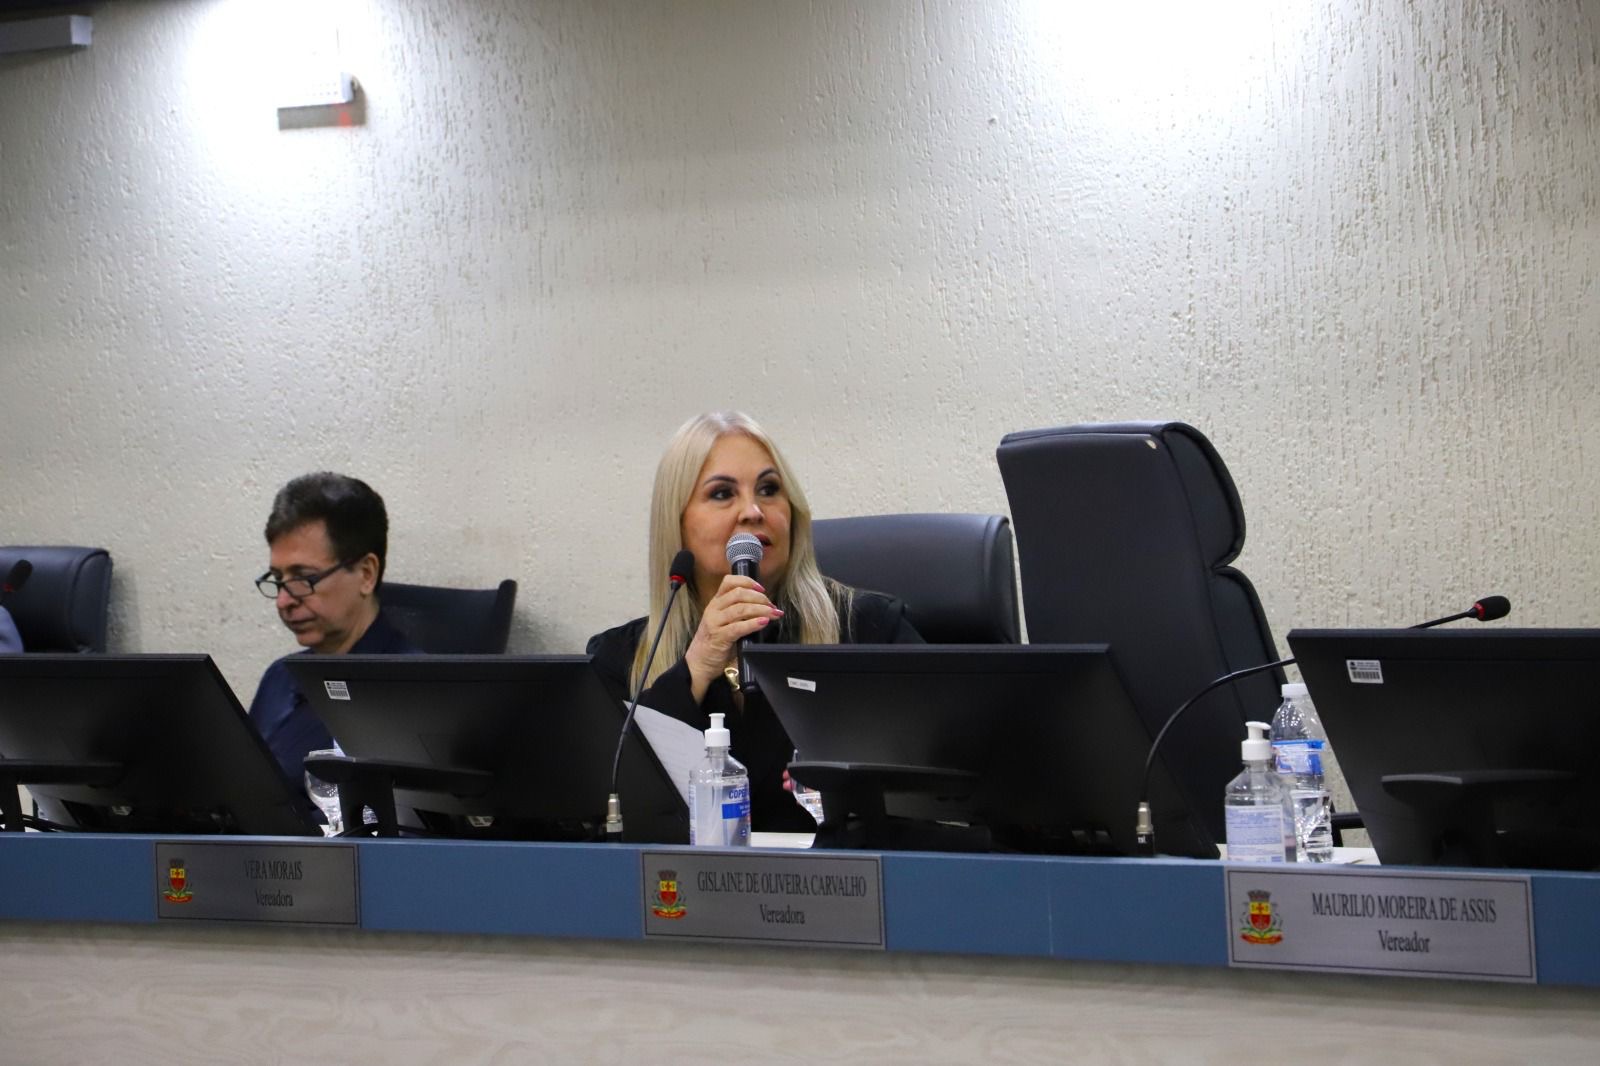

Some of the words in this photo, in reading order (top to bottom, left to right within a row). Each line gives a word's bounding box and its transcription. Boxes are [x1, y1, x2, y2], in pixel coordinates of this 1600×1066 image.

[244, 860, 268, 878] VERA
[269, 861, 303, 881] MORAIS
[697, 871, 744, 893] GISLAINE
[745, 872, 760, 894] DE
[761, 873, 811, 896] OLIVEIRA
[811, 875, 867, 898] CARVALHO
[255, 889, 294, 907] Vereadora
[1312, 892, 1375, 918] MAURILIO
[1377, 894, 1438, 921] MOREIRA
[1440, 897, 1458, 921] DE
[1460, 898, 1497, 923] ASSIS
[760, 904, 805, 924] Vereadora
[1378, 929, 1430, 953] Vereador
